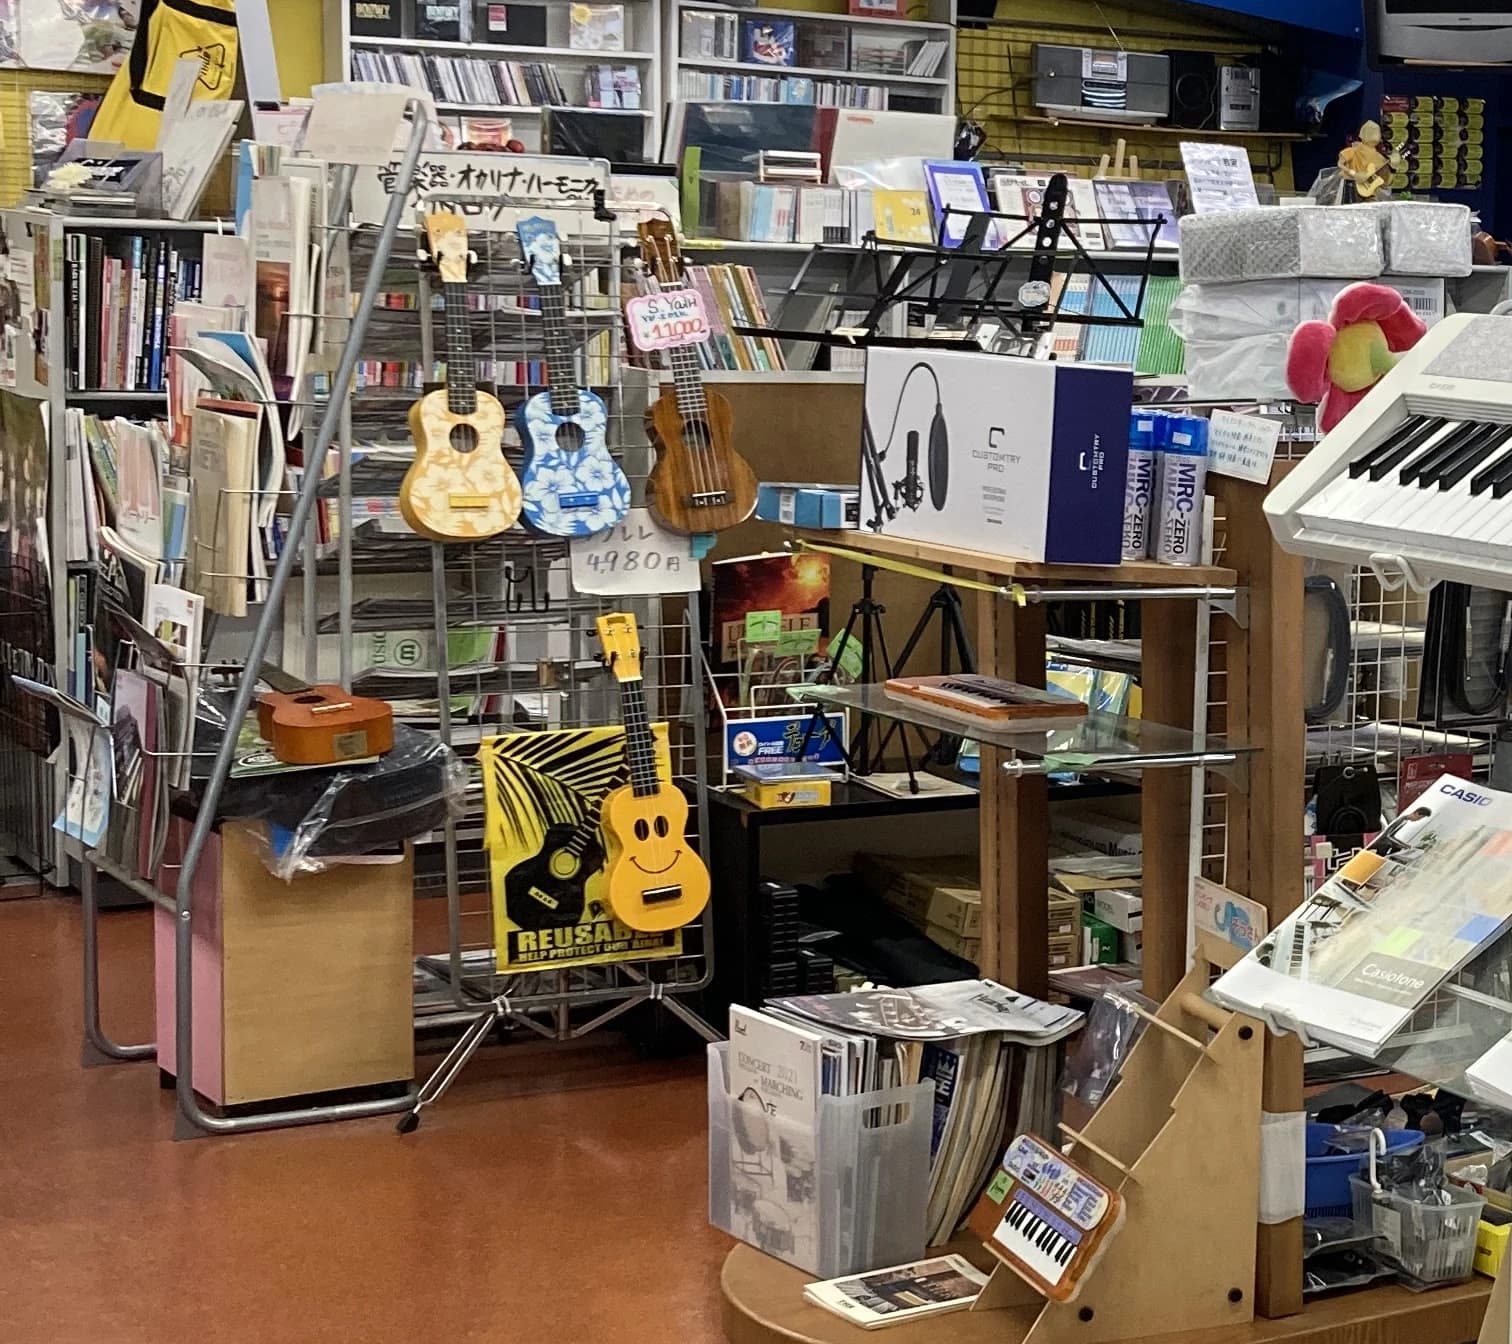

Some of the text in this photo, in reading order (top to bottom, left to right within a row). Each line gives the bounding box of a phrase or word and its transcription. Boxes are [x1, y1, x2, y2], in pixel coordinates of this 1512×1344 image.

[1133, 458, 1151, 550] MRC-ZERO
[1172, 463, 1196, 555] MRC-ZERO
[757, 746, 785, 756] FREE
[1439, 783, 1494, 808] CASIO
[551, 942, 601, 959] PROTECT
[1361, 962, 1425, 990] Casiotone
